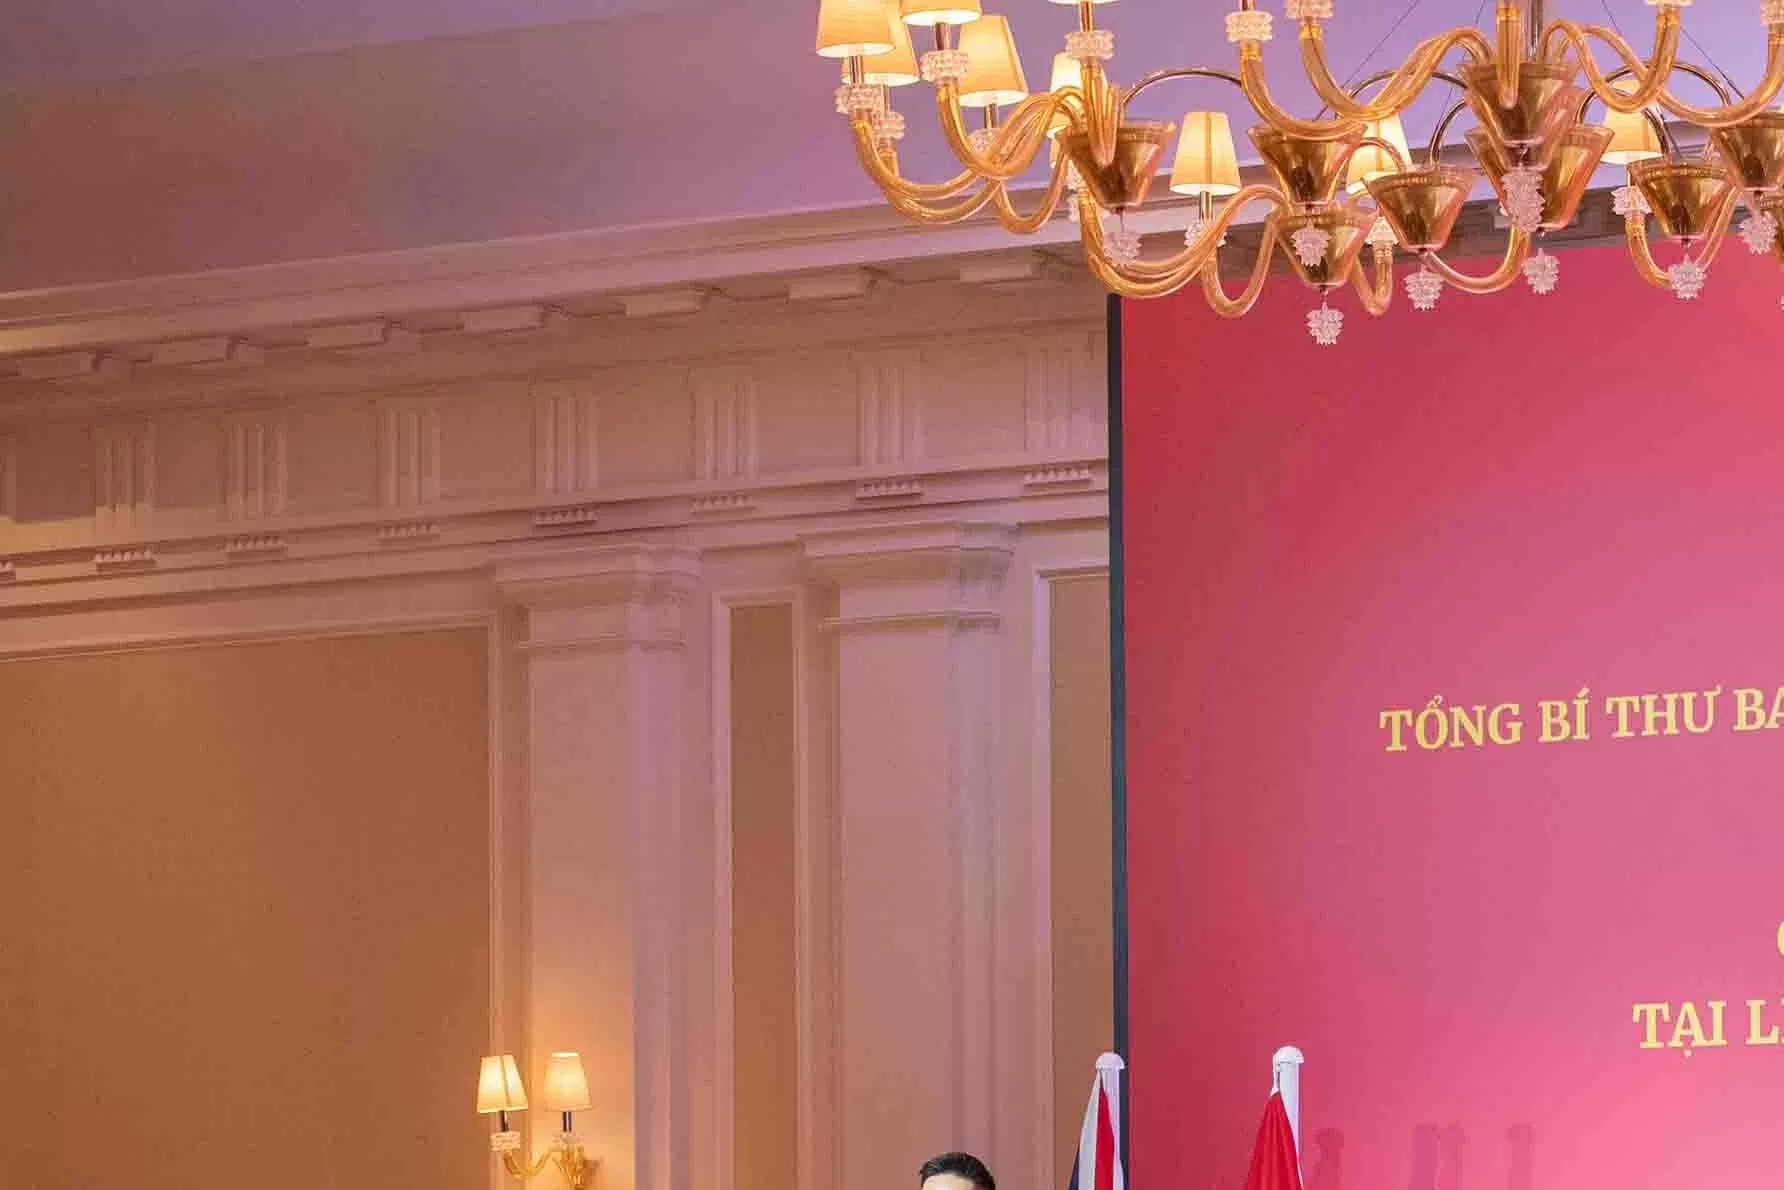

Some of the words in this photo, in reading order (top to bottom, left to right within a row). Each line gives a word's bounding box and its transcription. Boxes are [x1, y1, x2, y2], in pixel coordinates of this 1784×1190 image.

[1379, 694, 1523, 752] TỔNG
[1538, 687, 1590, 743] BÍ
[1605, 685, 1722, 738] THƯ
[1632, 999, 1728, 1057] TẠI
